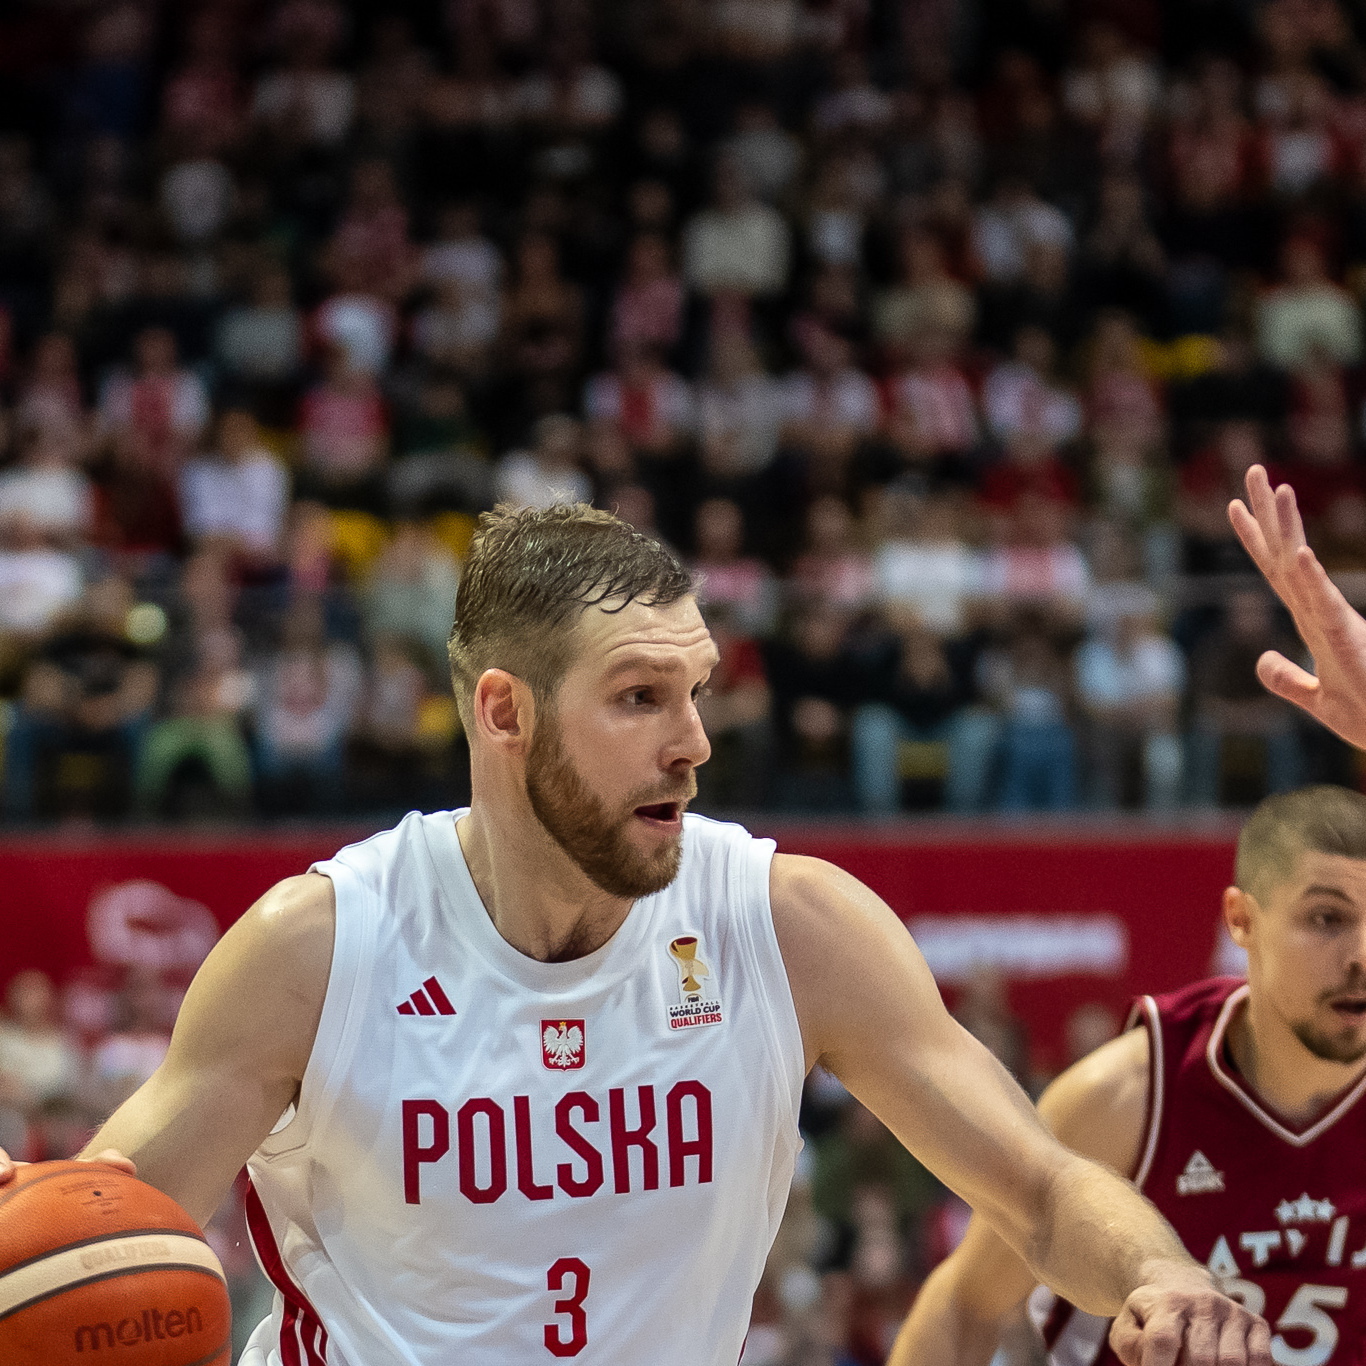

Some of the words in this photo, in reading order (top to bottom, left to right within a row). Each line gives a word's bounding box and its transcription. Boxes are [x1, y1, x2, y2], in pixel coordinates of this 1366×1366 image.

[670, 1008, 701, 1018] WORLD
[703, 1004, 720, 1013] CUP
[670, 1013, 722, 1028] QUALIFIERS
[401, 1079, 713, 1205] POLSKA
[75, 1306, 203, 1352] molten
[543, 1257, 591, 1358] 3
